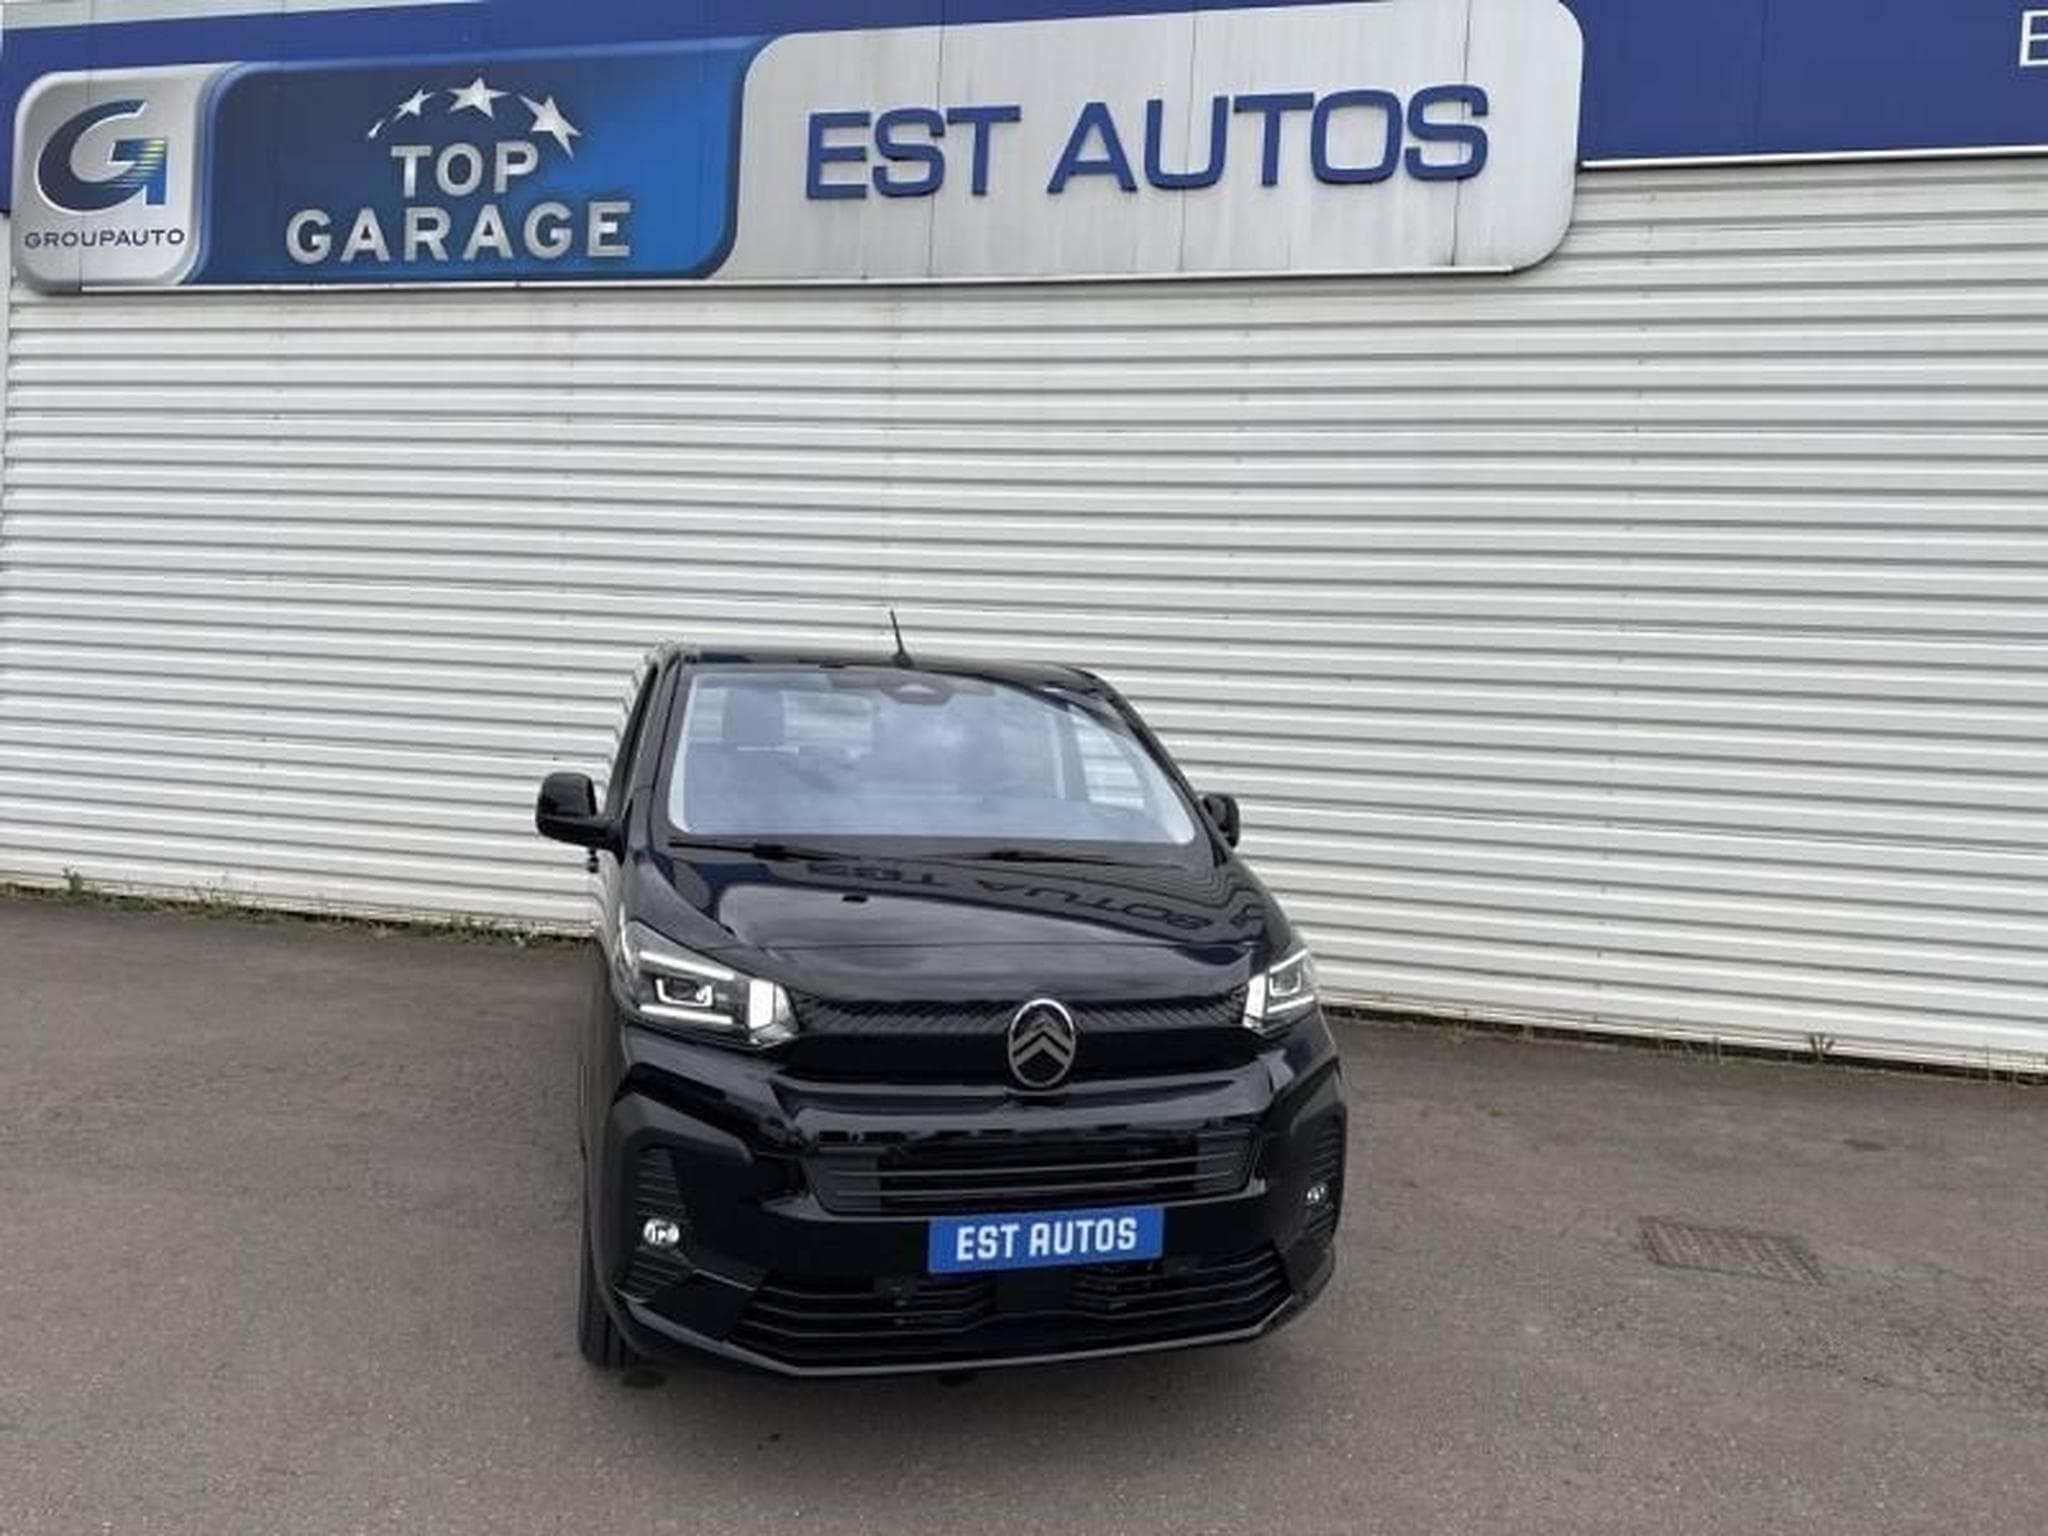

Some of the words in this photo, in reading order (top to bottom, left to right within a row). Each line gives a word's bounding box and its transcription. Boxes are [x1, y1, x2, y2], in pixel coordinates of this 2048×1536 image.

[390, 141, 539, 198] TOP
[806, 105, 1021, 200] EST
[1047, 84, 1489, 194] AUTOS
[25, 229, 185, 249] GROUPAUTO
[285, 202, 632, 264] GARAGE
[956, 1224, 1020, 1261] EST
[1029, 1217, 1137, 1257] AUTOS
